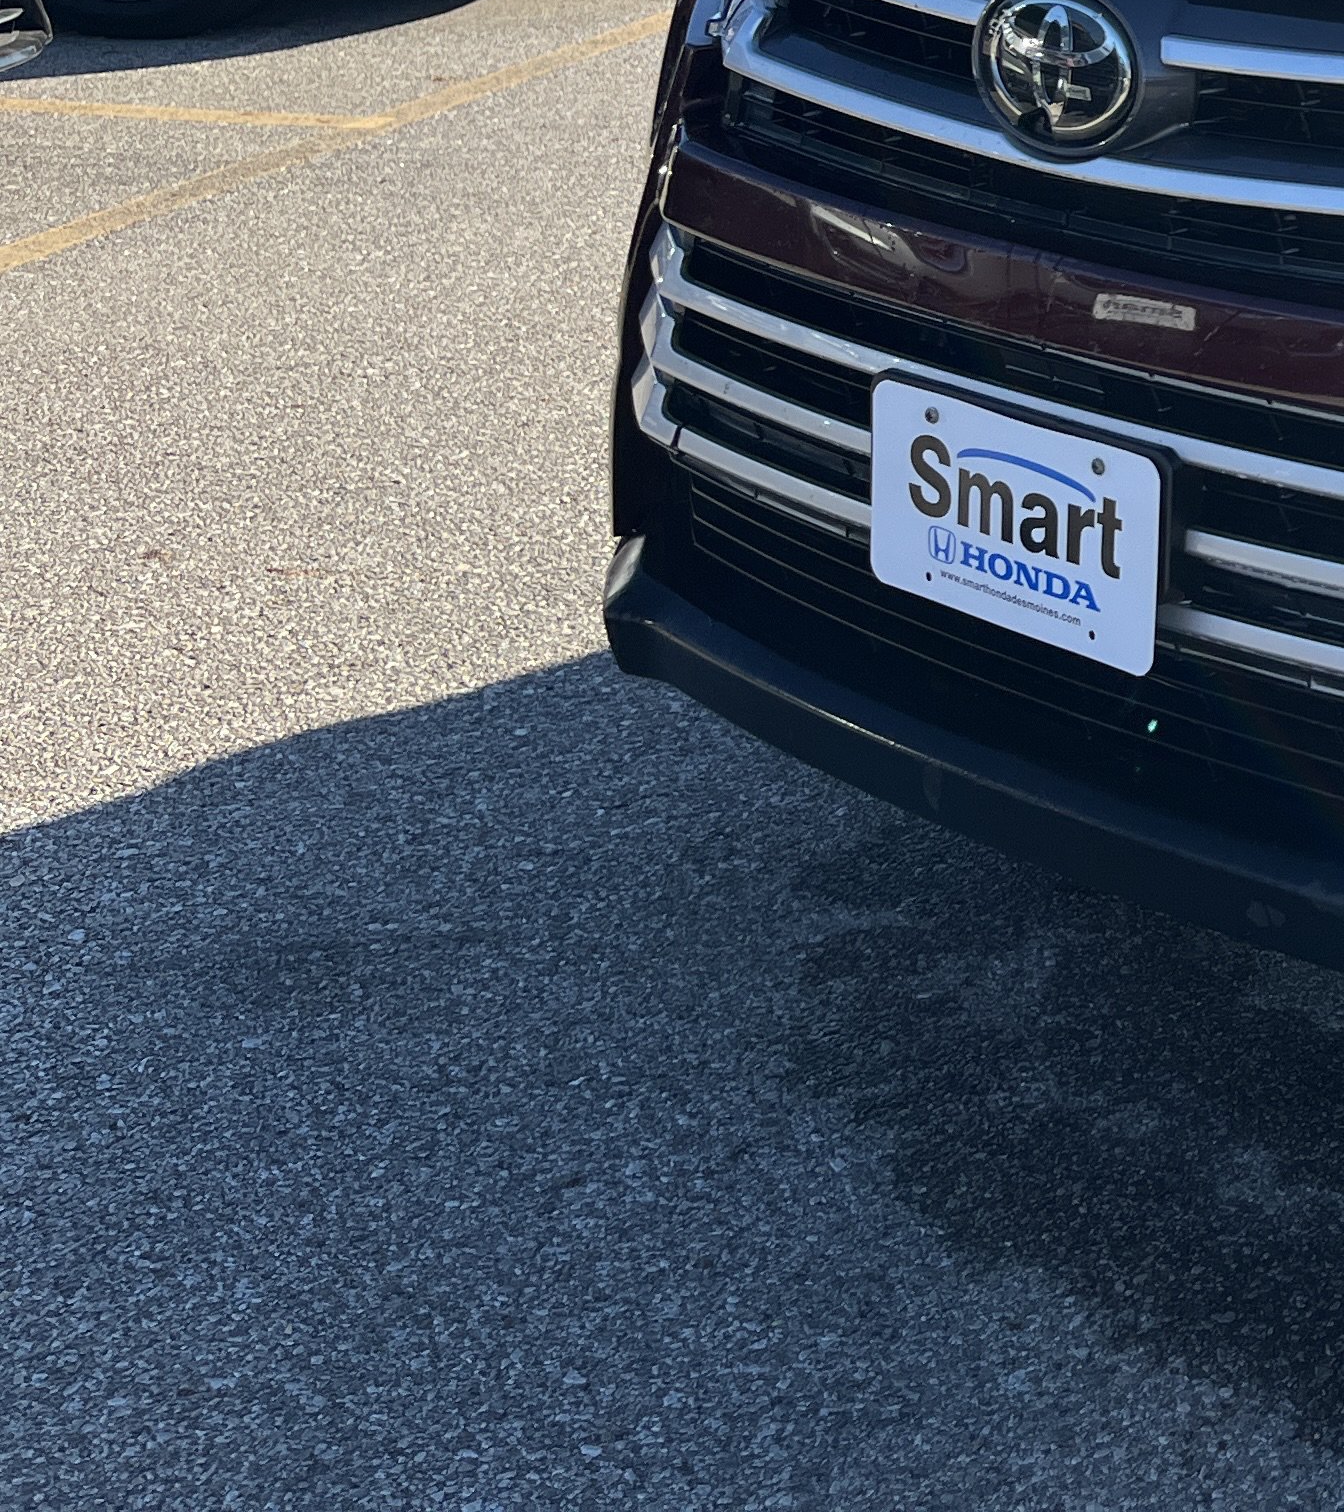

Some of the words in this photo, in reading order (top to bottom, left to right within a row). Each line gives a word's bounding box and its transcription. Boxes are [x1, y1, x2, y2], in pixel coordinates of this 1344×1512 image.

[908, 434, 1123, 580] Smart
[940, 569, 1082, 626] www.smarthondadesmoines.com
[960, 541, 1101, 612] HONDA
